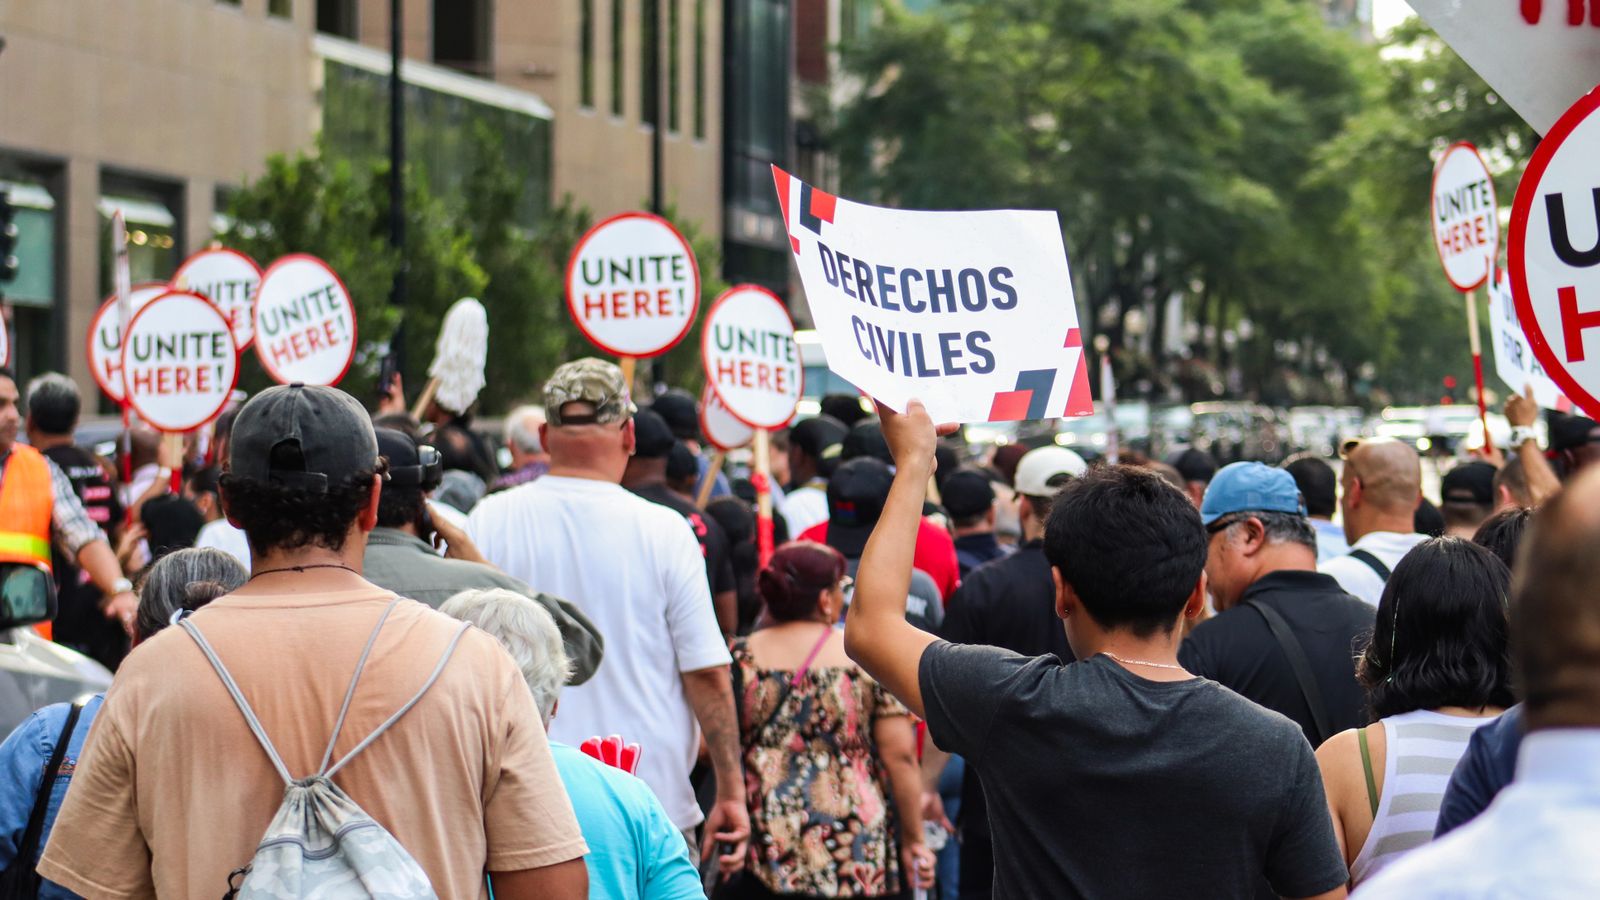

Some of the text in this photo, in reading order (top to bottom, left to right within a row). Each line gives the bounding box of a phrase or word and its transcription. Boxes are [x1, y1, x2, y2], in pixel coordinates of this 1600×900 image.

[1436, 179, 1490, 222] UNITE
[1441, 213, 1495, 260] HERE!
[582, 255, 685, 285] UNITE
[817, 240, 1018, 313] DERECHOS
[261, 283, 341, 336] UNITE
[584, 287, 684, 318] HERE!
[133, 332, 227, 361] UNITE
[270, 313, 349, 367] HERE!
[715, 324, 795, 363] UNITE
[851, 314, 996, 378] CIVILES
[134, 365, 225, 394] HERE!
[717, 356, 796, 398] HERE!
